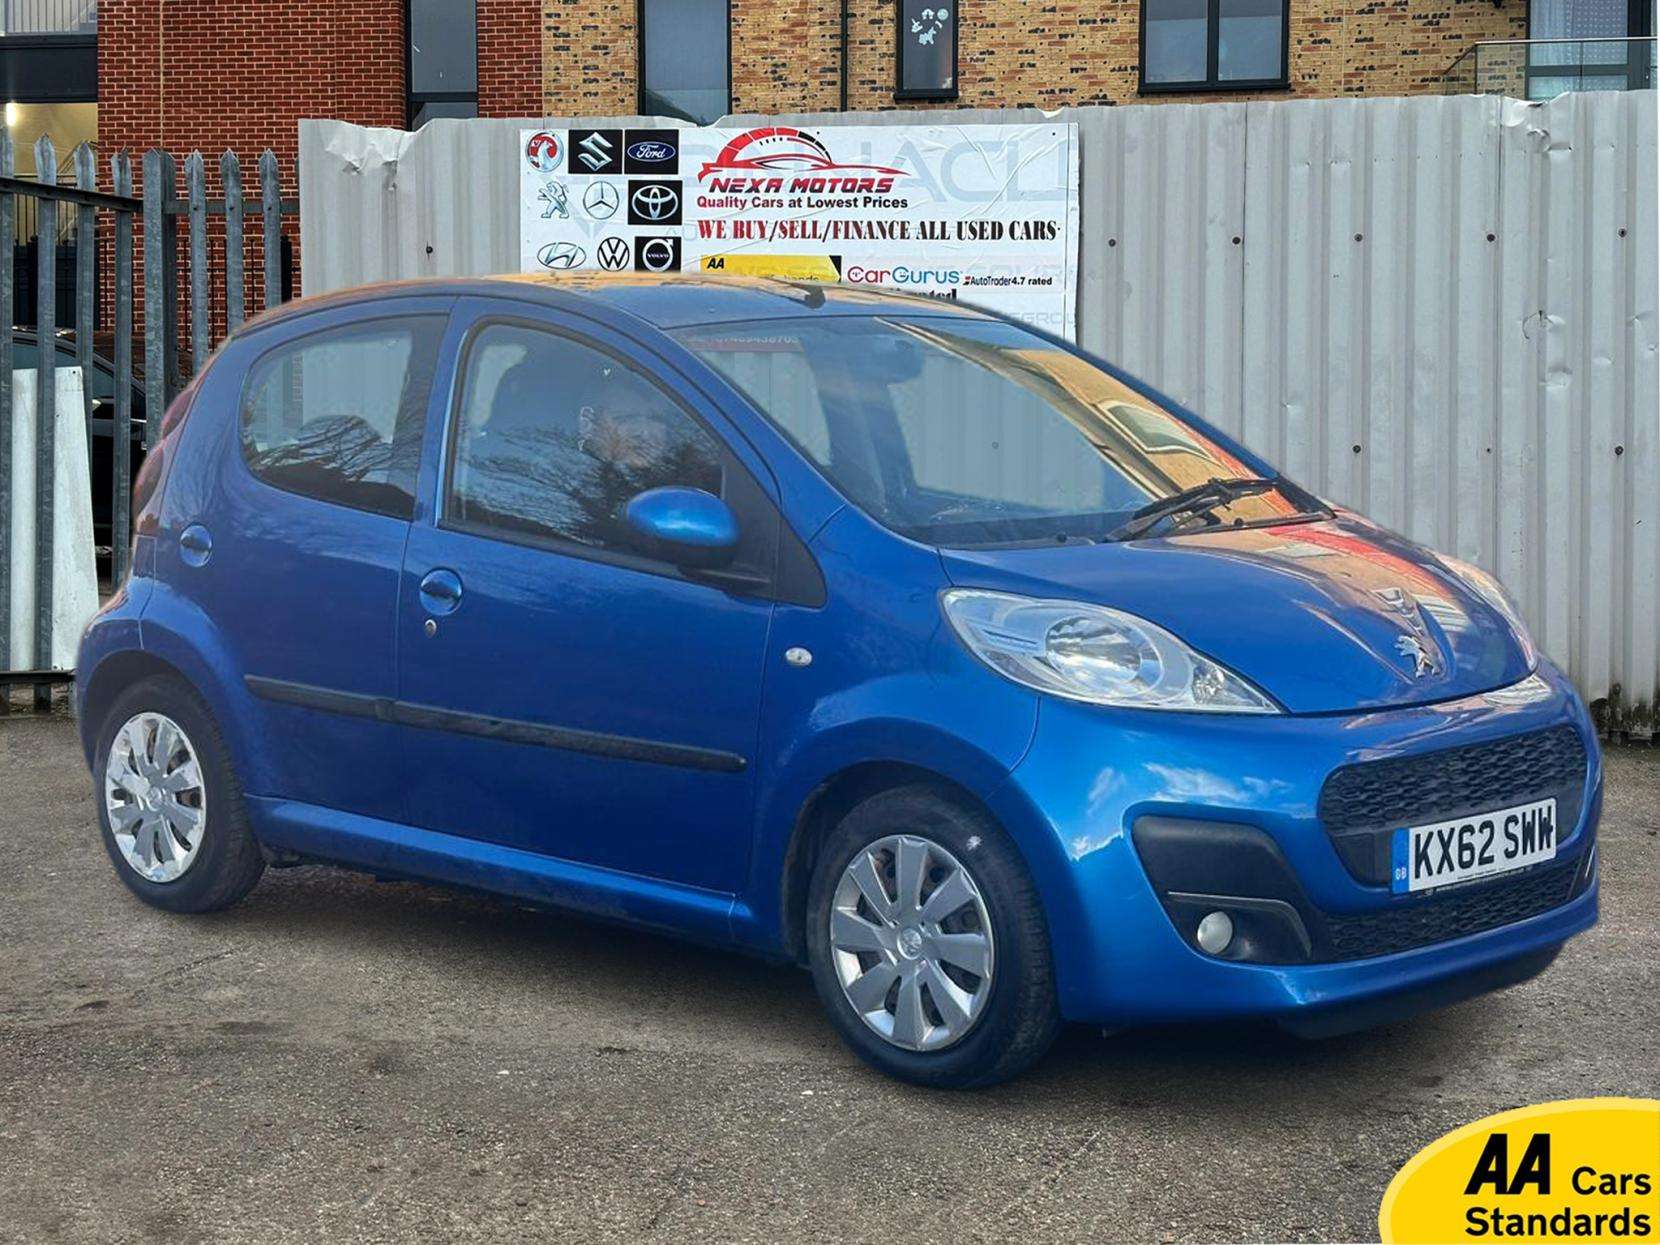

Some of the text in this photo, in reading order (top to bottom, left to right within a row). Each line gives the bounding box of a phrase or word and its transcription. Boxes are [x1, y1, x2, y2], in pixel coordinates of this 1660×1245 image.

[636, 144, 665, 159] Ford
[708, 177, 894, 193] NEXA MOTORS
[697, 196, 908, 210] Quality Cars at Lowest Prices
[697, 219, 727, 240] WE
[916, 220, 950, 240] ALL
[956, 220, 1003, 240] USED
[707, 258, 725, 269] AA
[847, 266, 960, 284] CarGurus
[1028, 277, 1053, 286] rated
[1414, 805, 1553, 879] KX62 SWW
